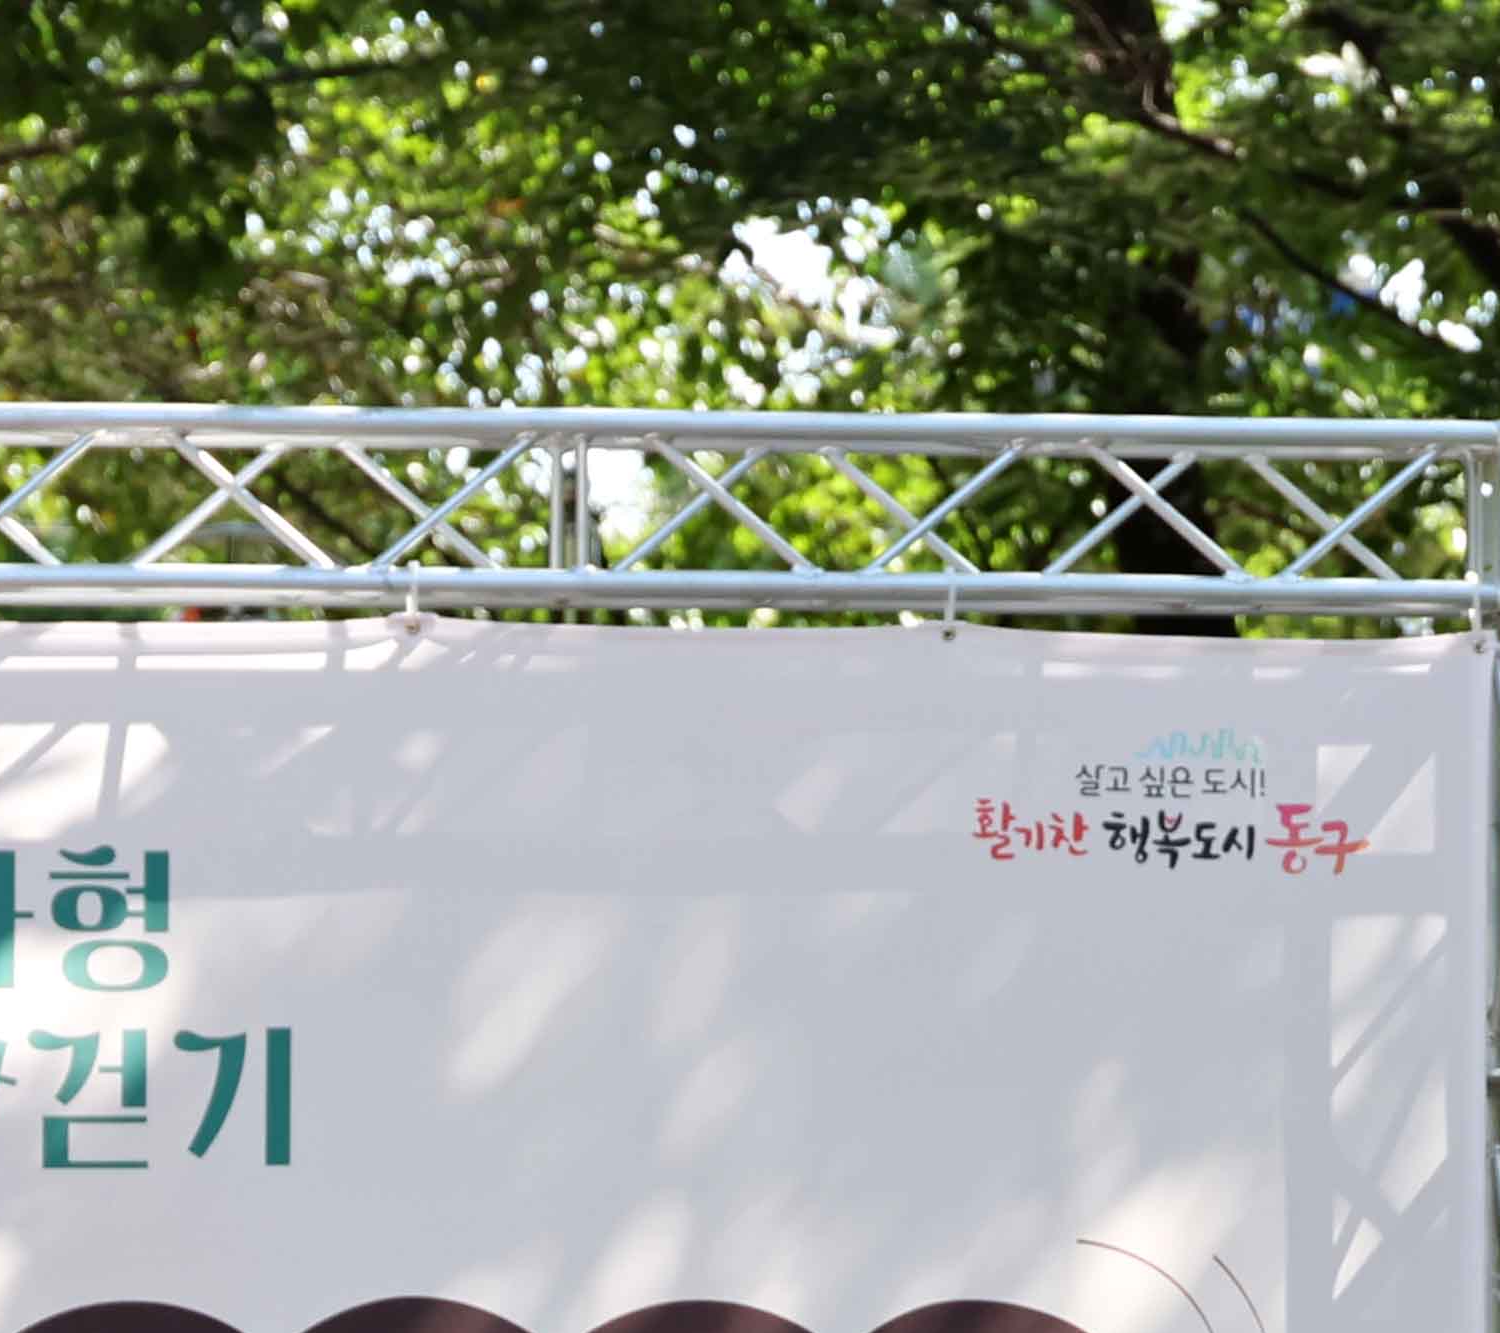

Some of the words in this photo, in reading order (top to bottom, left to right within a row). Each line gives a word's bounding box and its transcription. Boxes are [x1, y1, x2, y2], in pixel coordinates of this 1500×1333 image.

[1075, 764, 1131, 797] 살고
[1139, 766, 1194, 798] 싶은
[1203, 768, 1266, 798] 도시!
[972, 798, 1090, 862] 활기찬
[1102, 810, 1256, 869] 행복도시
[1265, 802, 1371, 875] 동구
